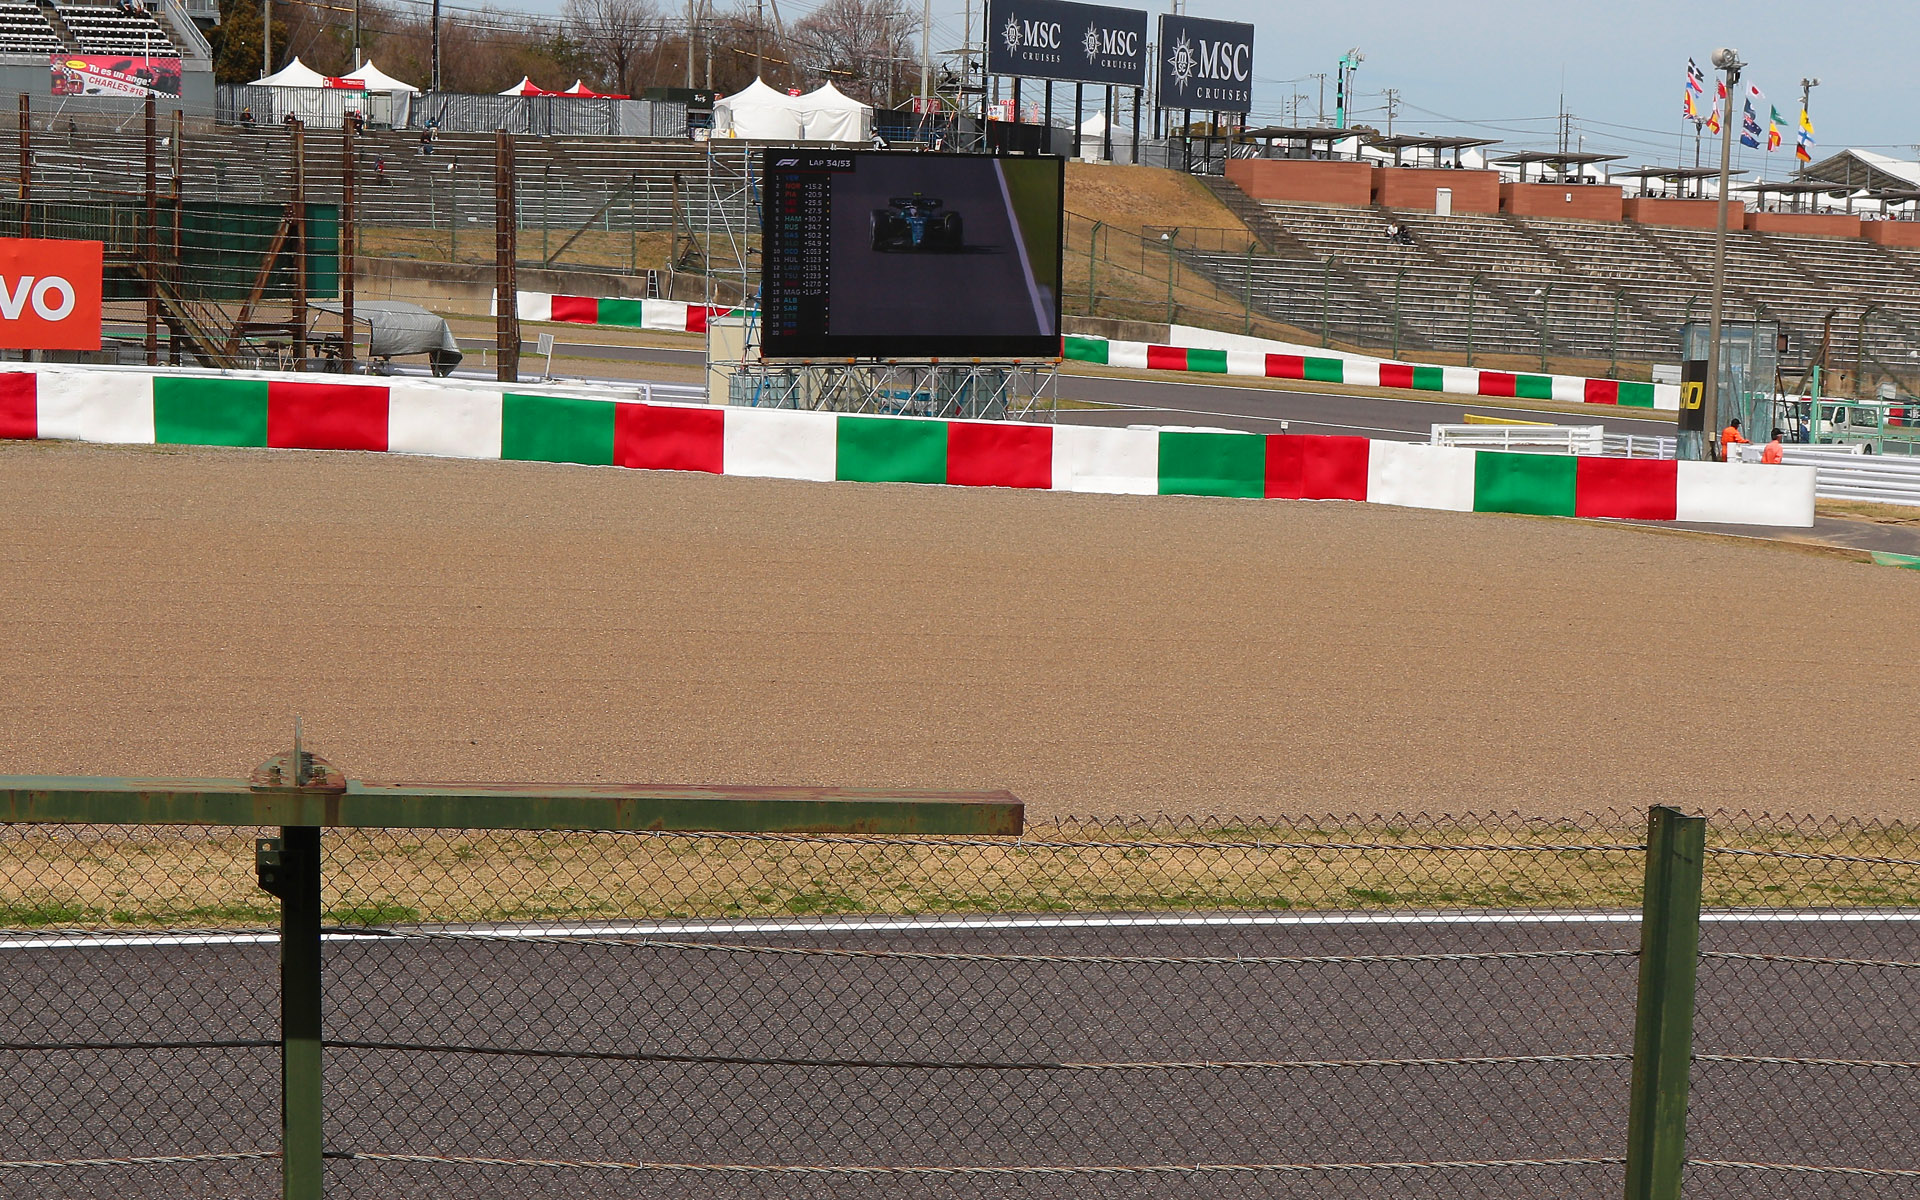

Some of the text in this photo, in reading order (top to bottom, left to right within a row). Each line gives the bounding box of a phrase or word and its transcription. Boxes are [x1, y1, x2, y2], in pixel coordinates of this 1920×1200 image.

[1023, 19, 1061, 49] MSC
[1101, 28, 1138, 57] MSC
[1022, 51, 1061, 63] CRUISES
[1101, 59, 1137, 70] CRUISES
[1197, 39, 1249, 82] MSC
[89, 64, 99, 73] Tu
[101, 68, 111, 76] es
[113, 70, 125, 79] un
[88, 77, 128, 91] CHARLES
[130, 88, 144, 96] #16
[1196, 87, 1248, 102] CRUISES
[826, 159, 851, 167] 34/53
